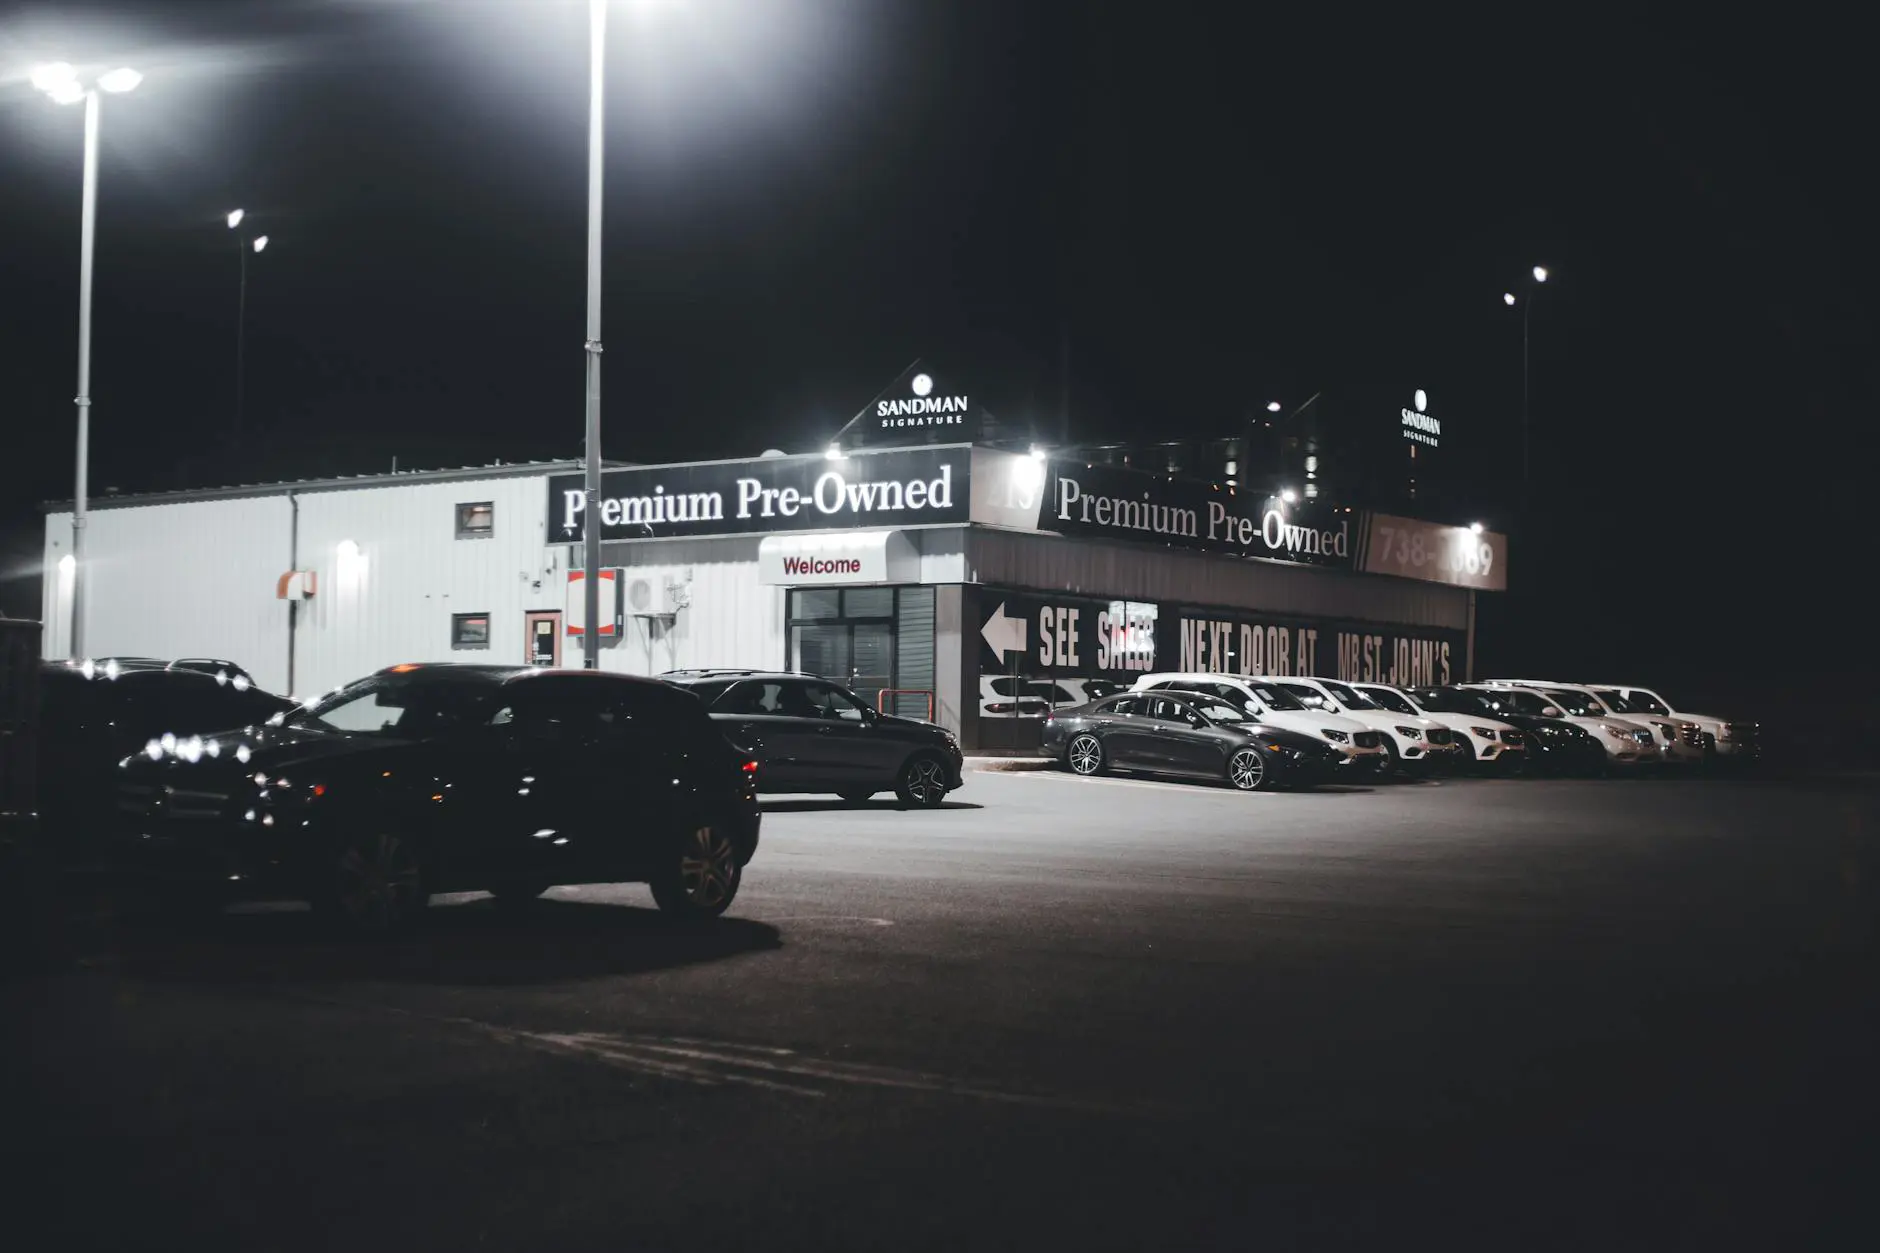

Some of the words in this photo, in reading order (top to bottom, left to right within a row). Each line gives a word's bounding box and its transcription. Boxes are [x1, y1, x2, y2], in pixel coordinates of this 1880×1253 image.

[877, 395, 968, 417] SANDMAN
[881, 415, 963, 428] SIGNATURE
[1401, 407, 1440, 435] SANDMAN
[563, 485, 724, 528] Pemium
[736, 464, 953, 519] Pre-Owned
[1058, 477, 1198, 537] Premium
[1207, 501, 1349, 558] Pre-Owned
[783, 556, 861, 575] Welcome
[1039, 605, 1080, 667] SEE
[1180, 618, 1233, 673] NEXT
[1240, 623, 1290, 677] DOOR
[1296, 628, 1317, 677] AT
[1389, 637, 1450, 687] JOHN'S
